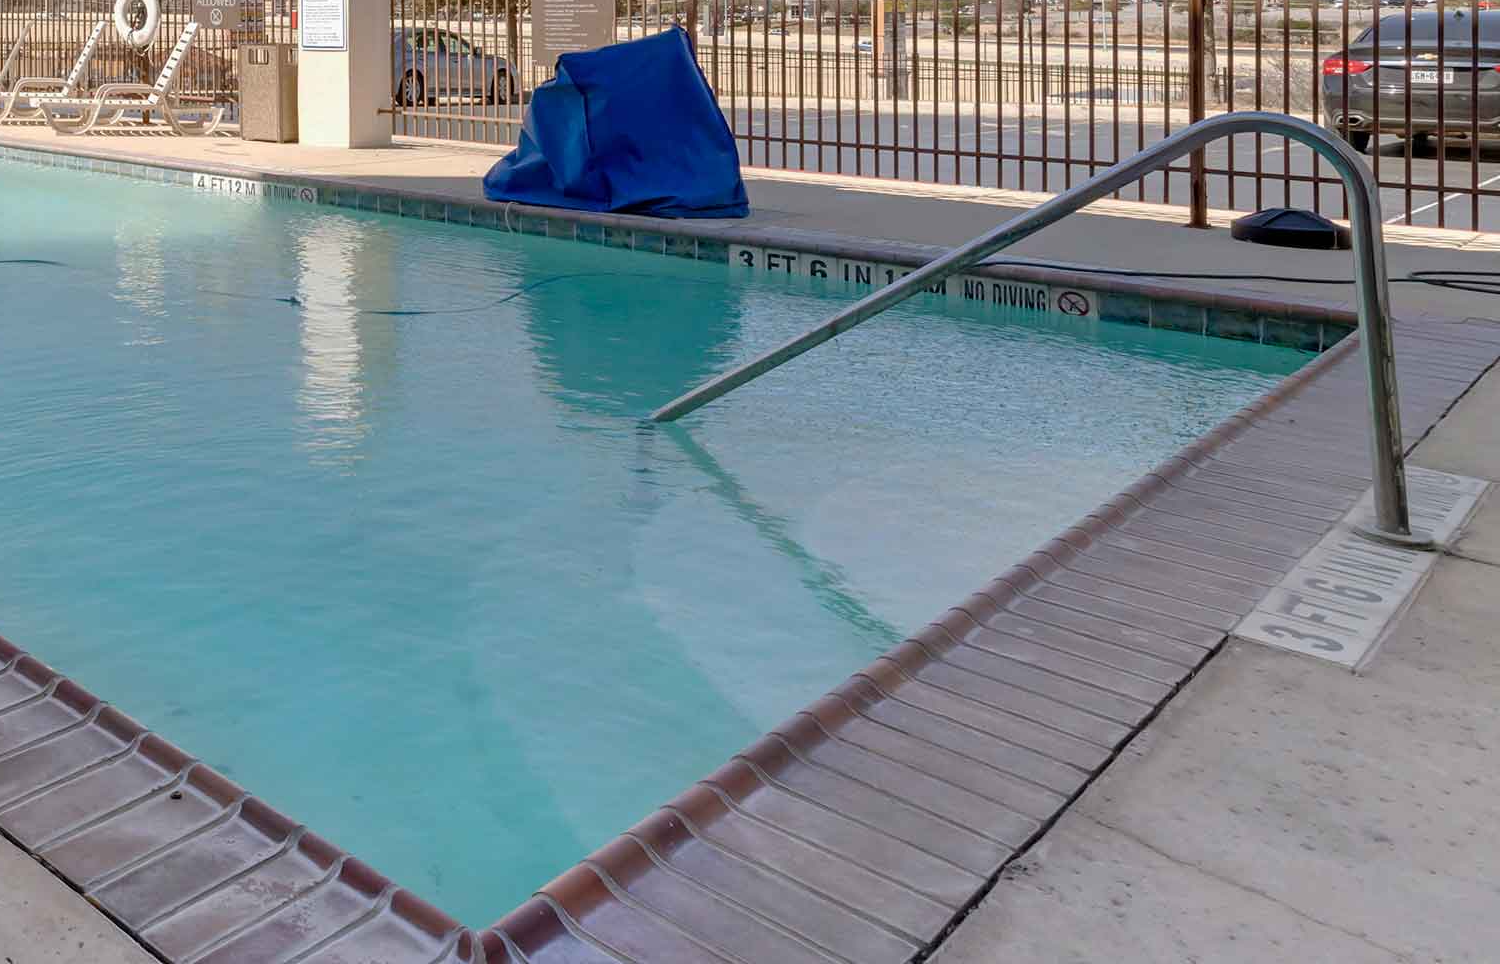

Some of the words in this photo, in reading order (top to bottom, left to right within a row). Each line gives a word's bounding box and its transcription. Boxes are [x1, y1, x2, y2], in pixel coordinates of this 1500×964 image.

[197, 176, 205, 188] 4
[211, 177, 225, 191] FT
[245, 182, 257, 196] M
[739, 250, 754, 268] 3
[767, 253, 797, 274] FT
[810, 259, 828, 278] 6
[844, 263, 871, 285] IN
[964, 279, 986, 301] NO
[993, 283, 1046, 312] DIVING
[1303, 577, 1384, 603] 6
[1275, 594, 1369, 635] FT
[1259, 624, 1345, 652] 3
